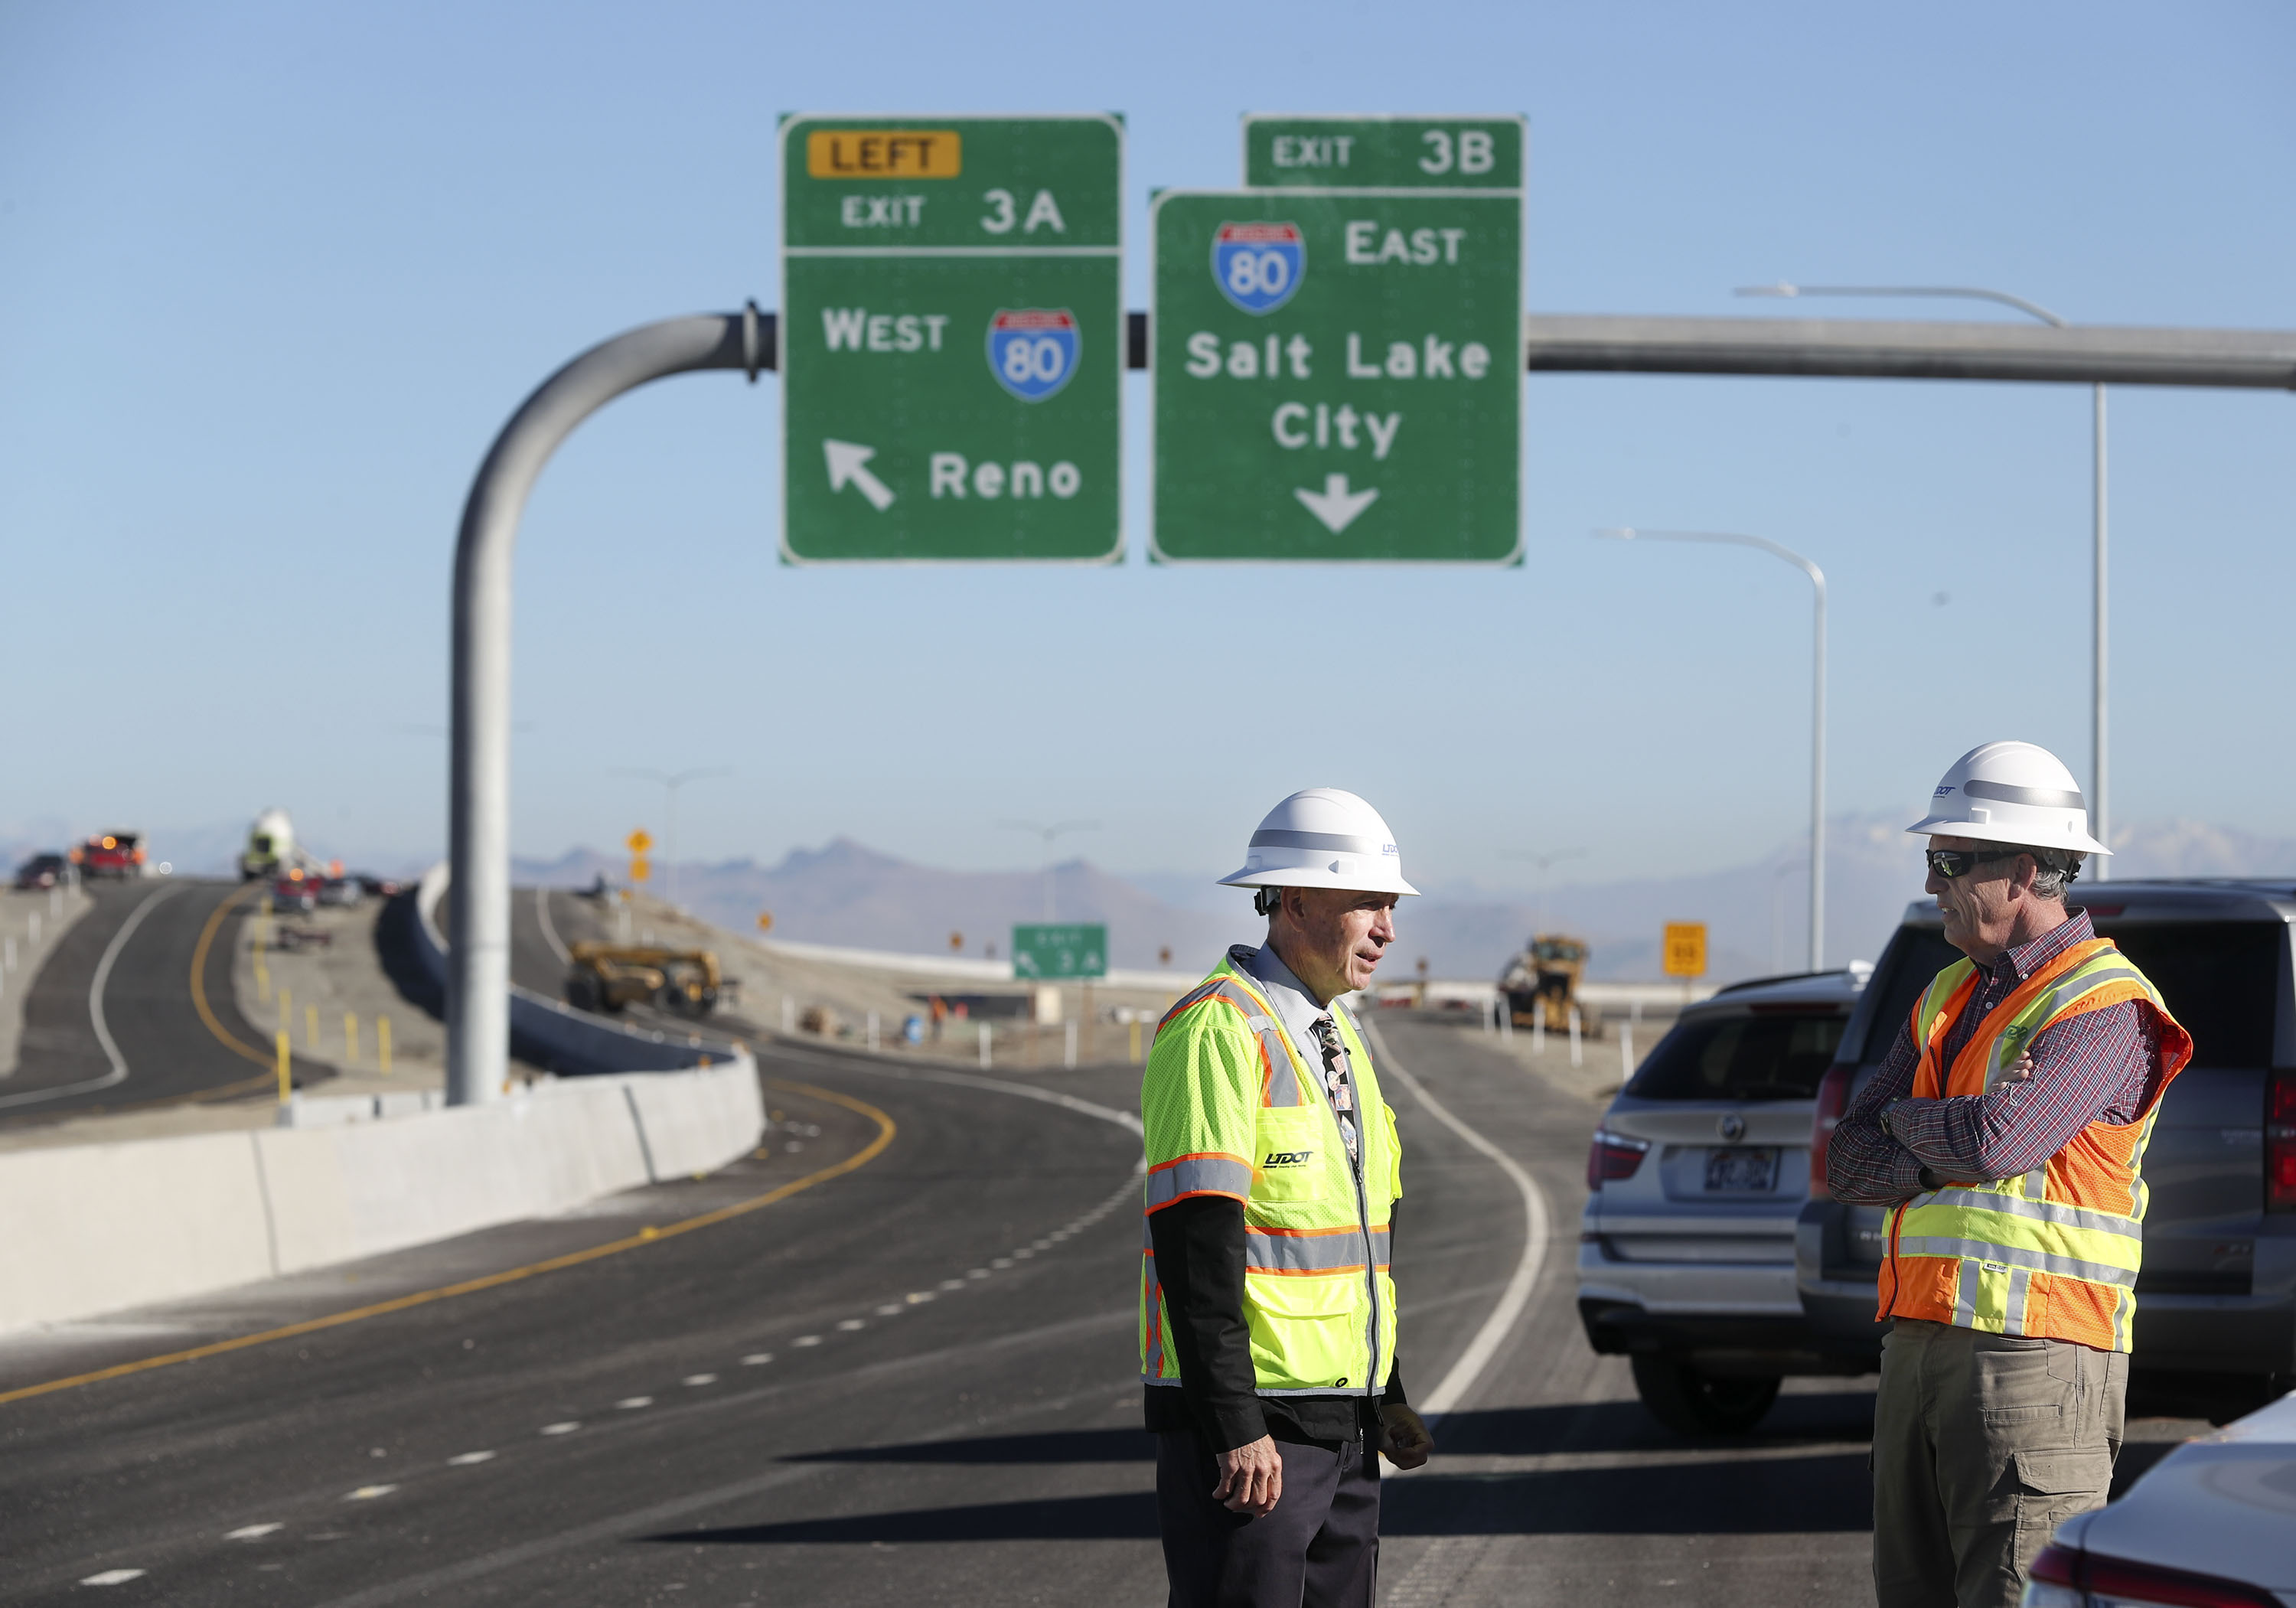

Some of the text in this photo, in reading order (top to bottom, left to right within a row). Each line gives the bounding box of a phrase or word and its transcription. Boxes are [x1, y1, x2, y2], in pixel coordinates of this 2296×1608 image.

[831, 137, 936, 171] LEFT
[1271, 129, 1495, 174] EXIT 3B
[842, 188, 1065, 234] EXIT 3A
[1345, 220, 1466, 265] EAST
[1228, 250, 1290, 295] 80
[822, 308, 949, 352] WEST
[1003, 337, 1065, 383] 80
[1186, 331, 1491, 378] Salt Lake
[1271, 402, 1401, 460] City
[930, 452, 1081, 498] Reno
[1265, 1151, 1313, 1164] UDOT
